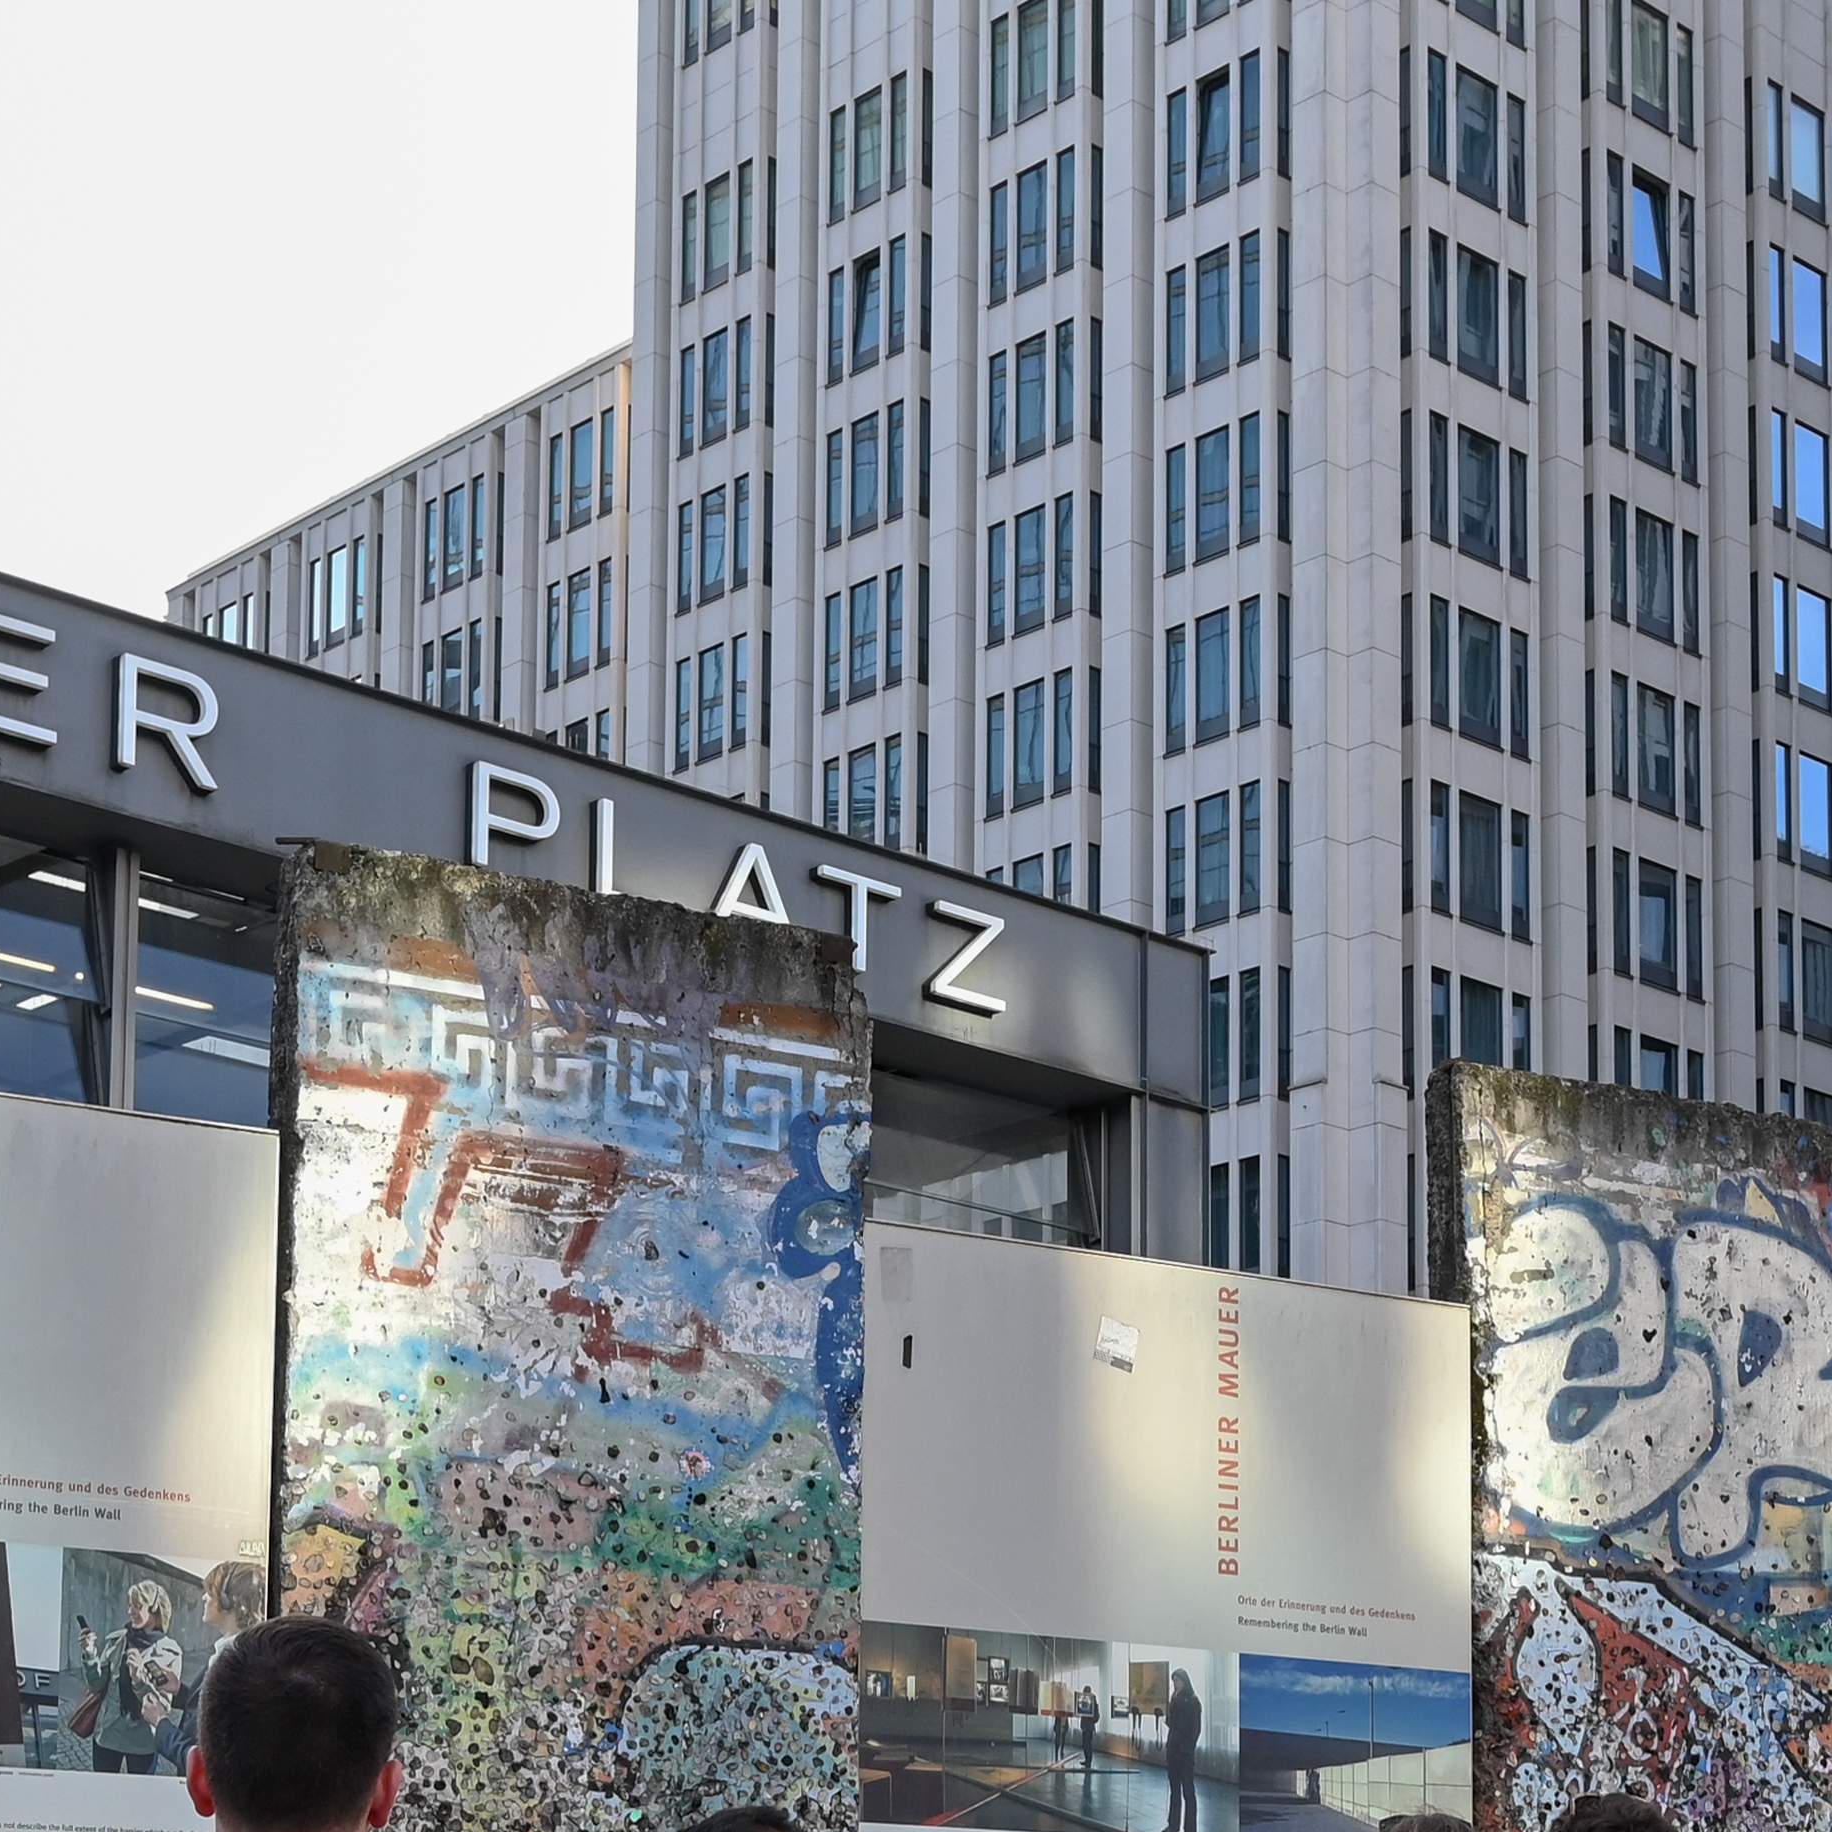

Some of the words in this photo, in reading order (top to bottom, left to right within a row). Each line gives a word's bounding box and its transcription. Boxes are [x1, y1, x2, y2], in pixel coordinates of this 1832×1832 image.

[467, 760, 1007, 1020] PLATZ
[1218, 1286, 1239, 1398] MAUER
[68, 1482, 91, 1493] und
[97, 1483, 118, 1495] des
[123, 1486, 190, 1501] Gedenkens
[1218, 1416, 1239, 1576] BERLINER
[28, 1501, 48, 1514] the
[53, 1504, 89, 1517] Berlin
[94, 1507, 120, 1520] Wall
[1237, 1595, 1257, 1606] Orte
[1260, 1597, 1275, 1607] der
[1278, 1599, 1326, 1614] Erinnerung
[1329, 1605, 1346, 1614] und
[1349, 1606, 1365, 1616] des
[1368, 1608, 1415, 1620] Gedenkens
[1238, 1616, 1298, 1632] Remembering
[1302, 1622, 1316, 1632] the
[1319, 1623, 1345, 1634] Berlin
[1348, 1626, 1367, 1636] Wall
